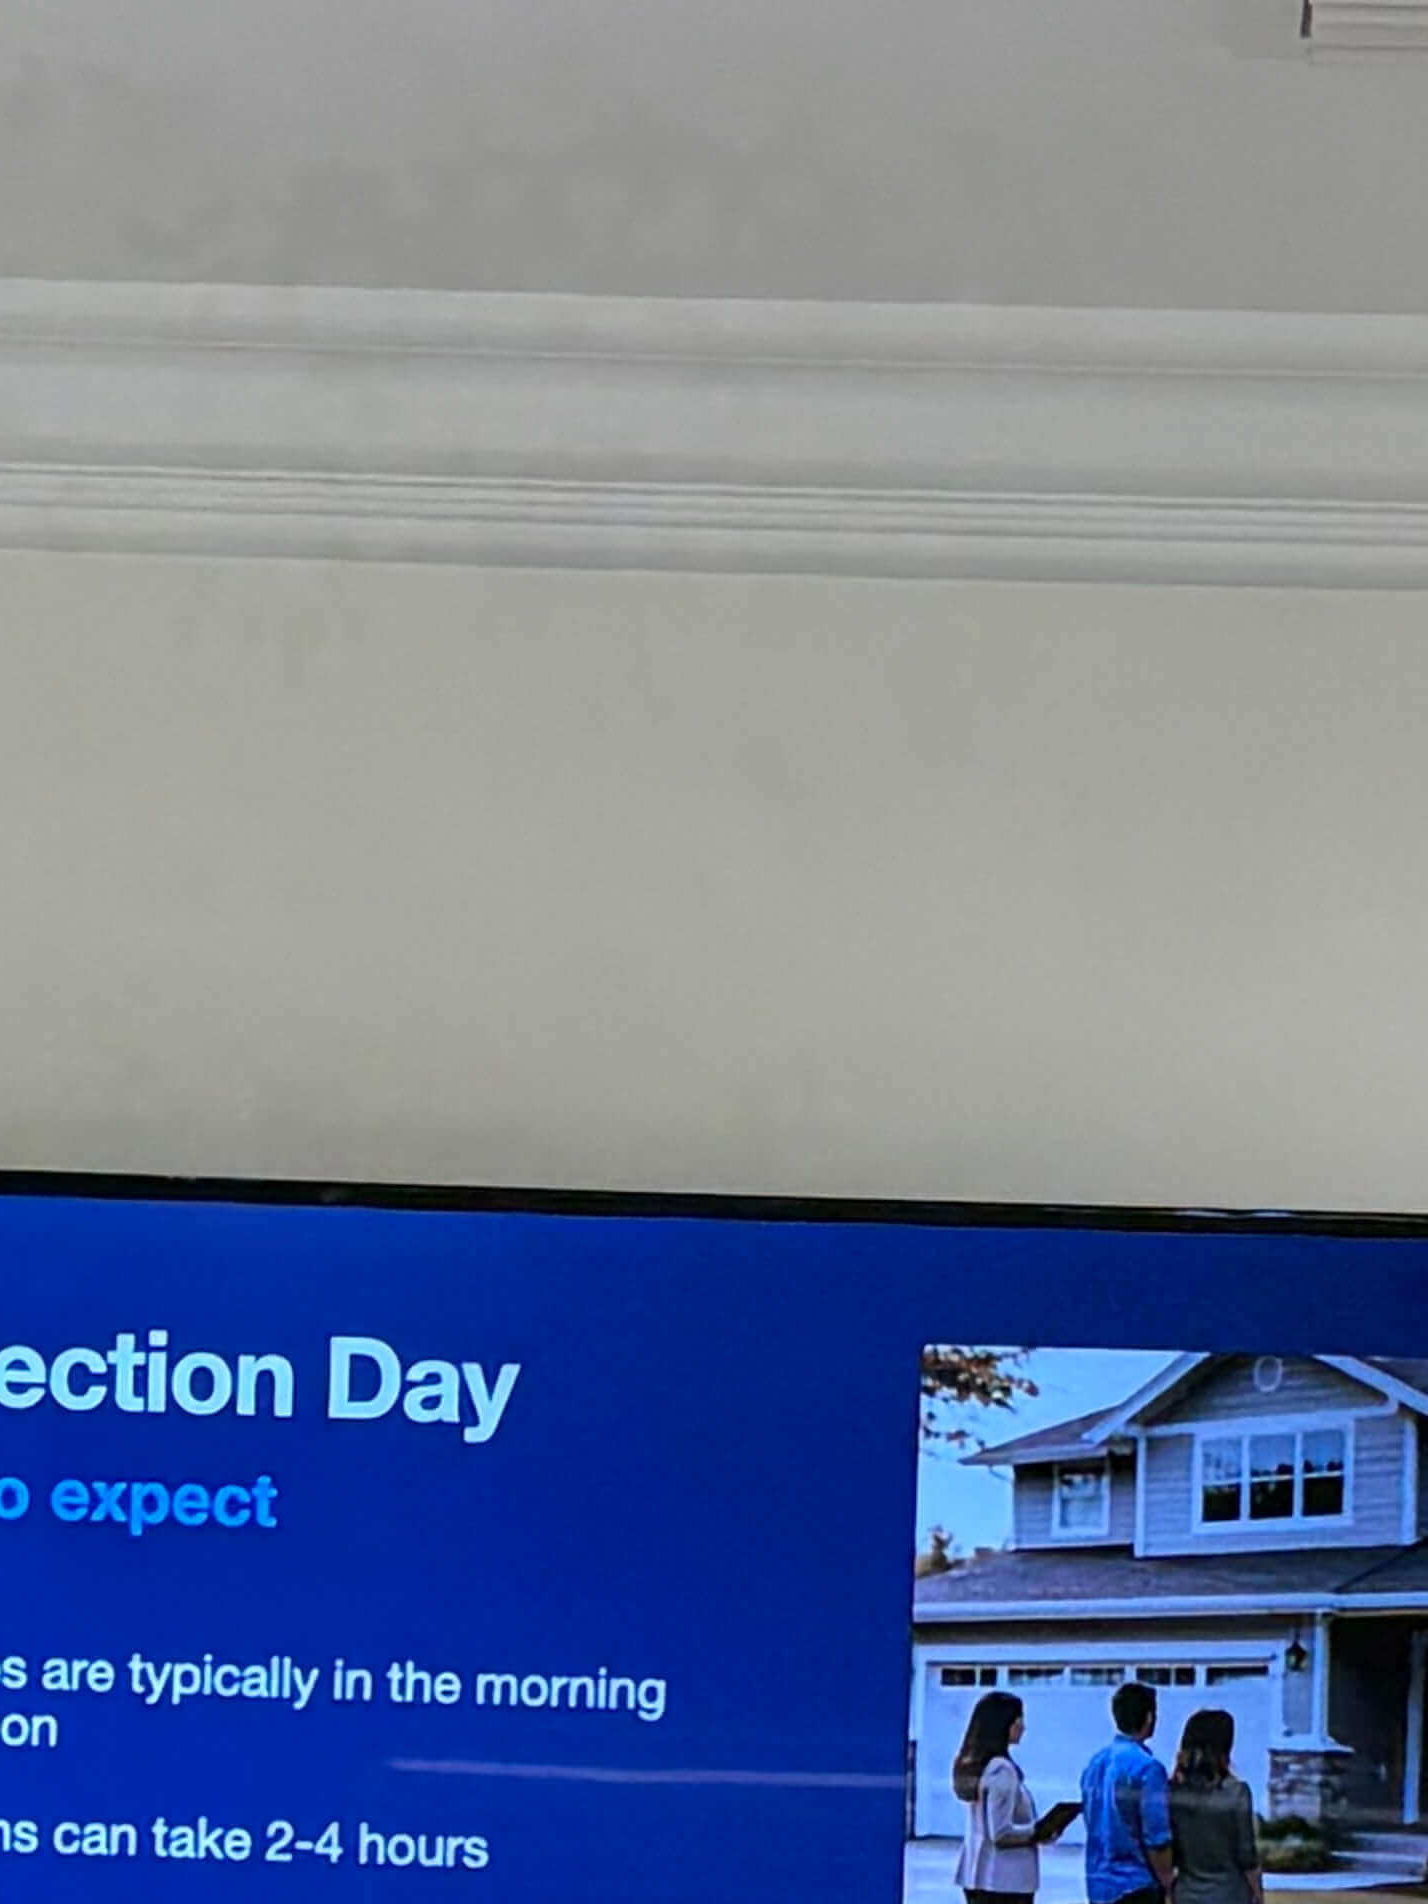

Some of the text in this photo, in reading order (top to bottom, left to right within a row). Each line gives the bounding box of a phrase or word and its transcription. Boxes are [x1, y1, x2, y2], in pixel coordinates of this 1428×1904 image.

[328, 1336, 521, 1443] Day
[52, 1476, 277, 1536] expect
[42, 1658, 115, 1692] are
[127, 1653, 319, 1710] typically
[334, 1659, 372, 1701] in
[386, 1660, 461, 1704] the
[476, 1667, 666, 1721] morning
[53, 1822, 137, 1856] can
[152, 1816, 252, 1861] take
[265, 1820, 343, 1863] 2-4
[359, 1822, 489, 1868] hours
